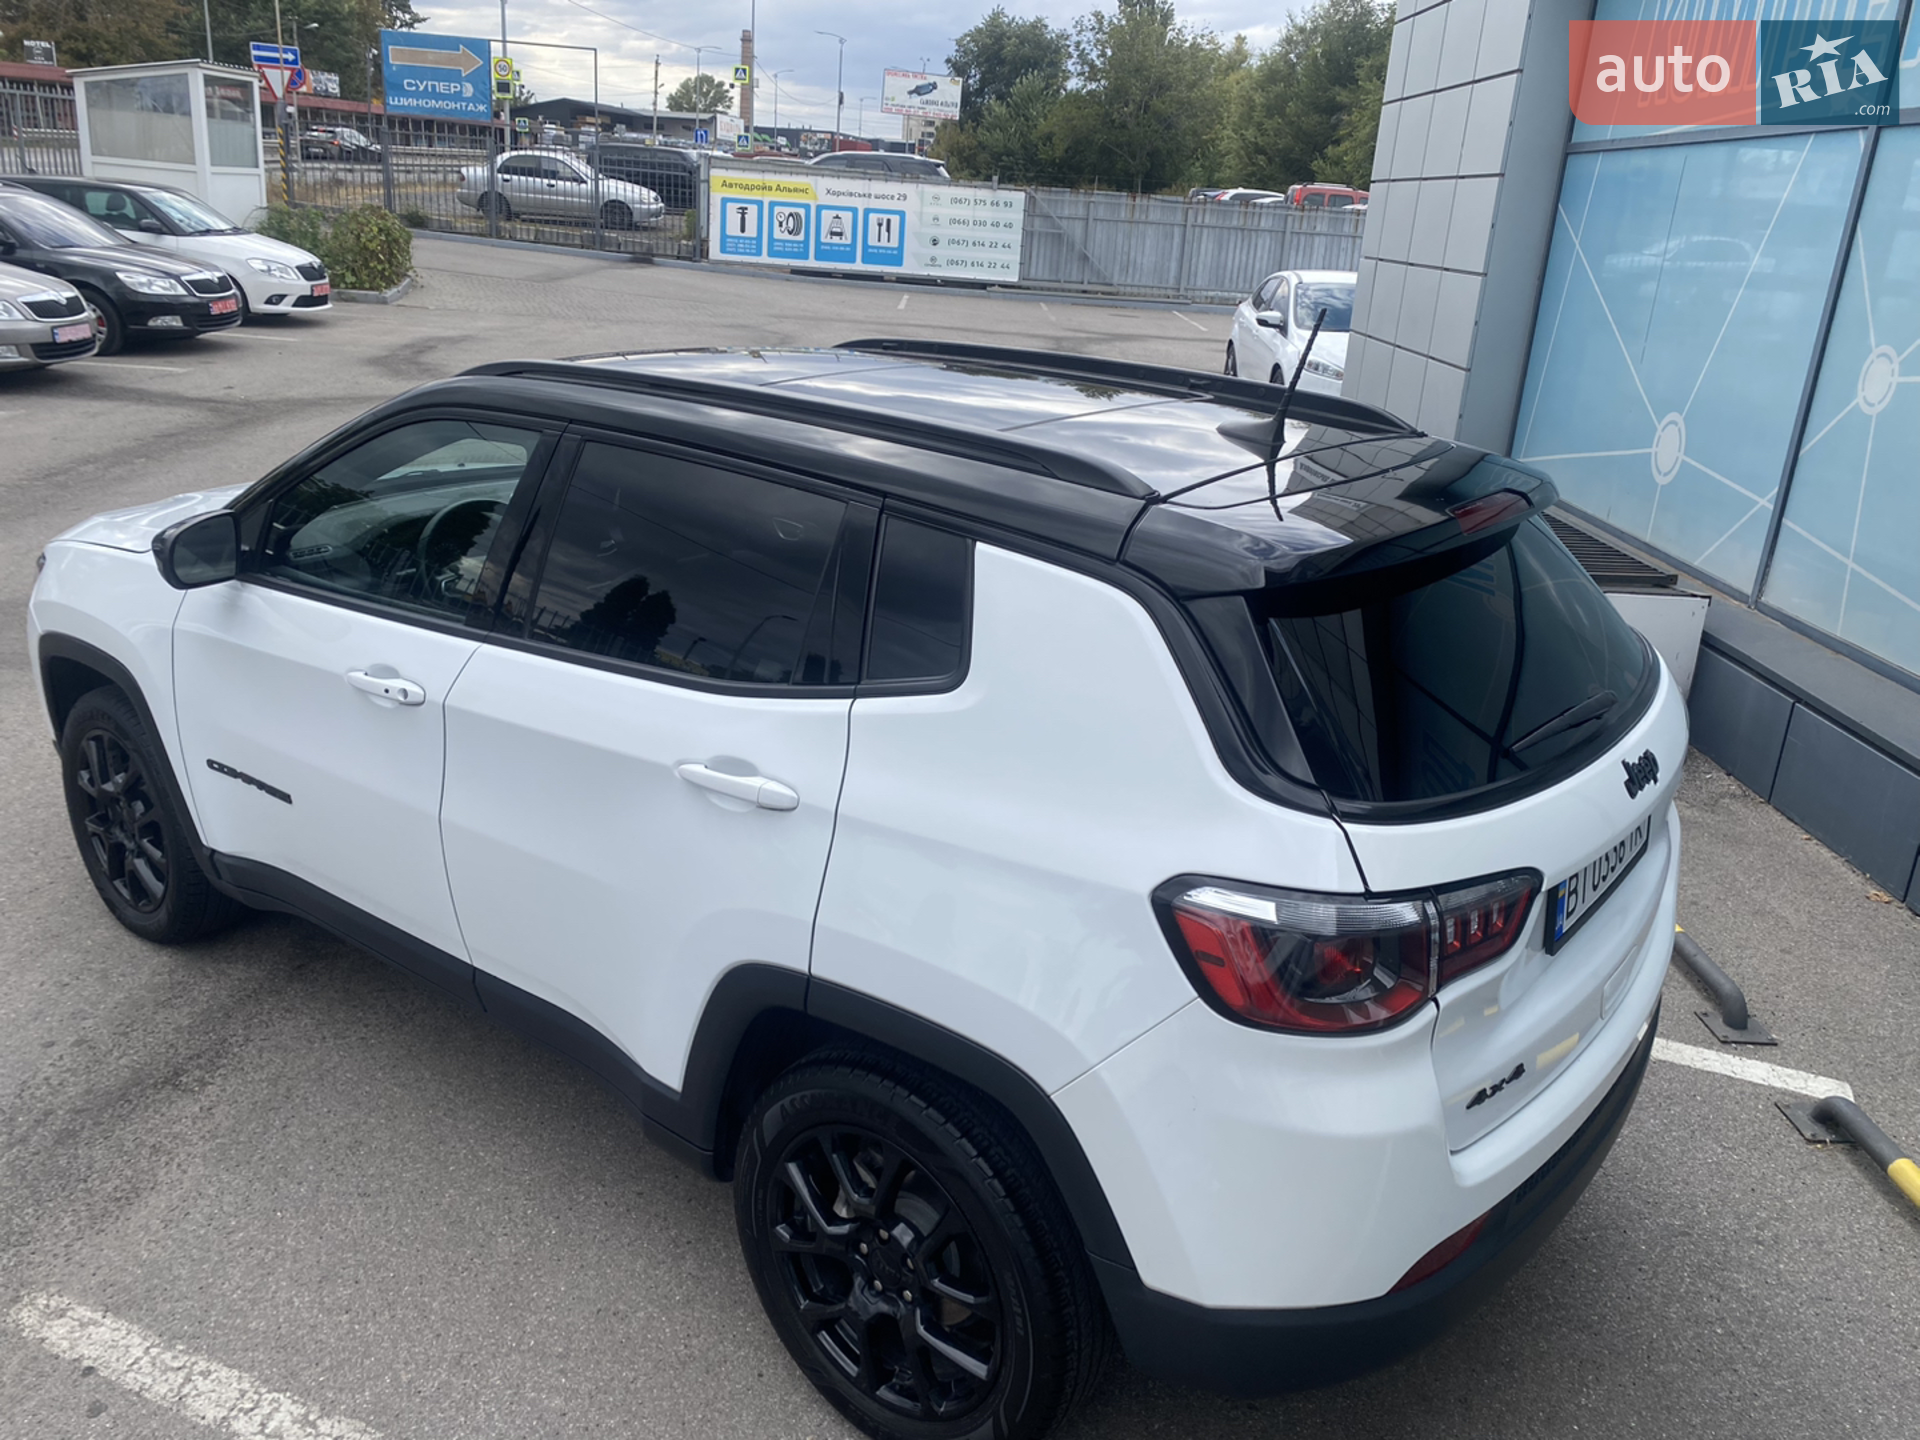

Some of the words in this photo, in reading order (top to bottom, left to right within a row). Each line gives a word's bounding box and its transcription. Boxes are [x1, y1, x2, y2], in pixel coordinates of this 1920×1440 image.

[403, 79, 461, 94] СУПЕР
[389, 96, 487, 112] ШИНОМОНТАЖ
[775, 184, 809, 195] Альянс
[874, 192, 894, 200] шосе
[896, 192, 908, 201] 29
[950, 197, 970, 206] (067)
[973, 198, 987, 206] 575
[990, 199, 1000, 207] 66
[1003, 200, 1013, 208] 93
[972, 219, 987, 227] 030
[990, 220, 1000, 228] 40
[1003, 221, 1014, 229] 40
[947, 238, 969, 247] (067)
[971, 239, 986, 247] 614
[988, 240, 998, 248] 22
[1001, 241, 1012, 249] 44
[946, 259, 968, 268] (067)
[970, 260, 985, 268] 614
[987, 261, 997, 269] 22
[1000, 262, 1010, 270] 44
[1621, 748, 1660, 800] Jeep
